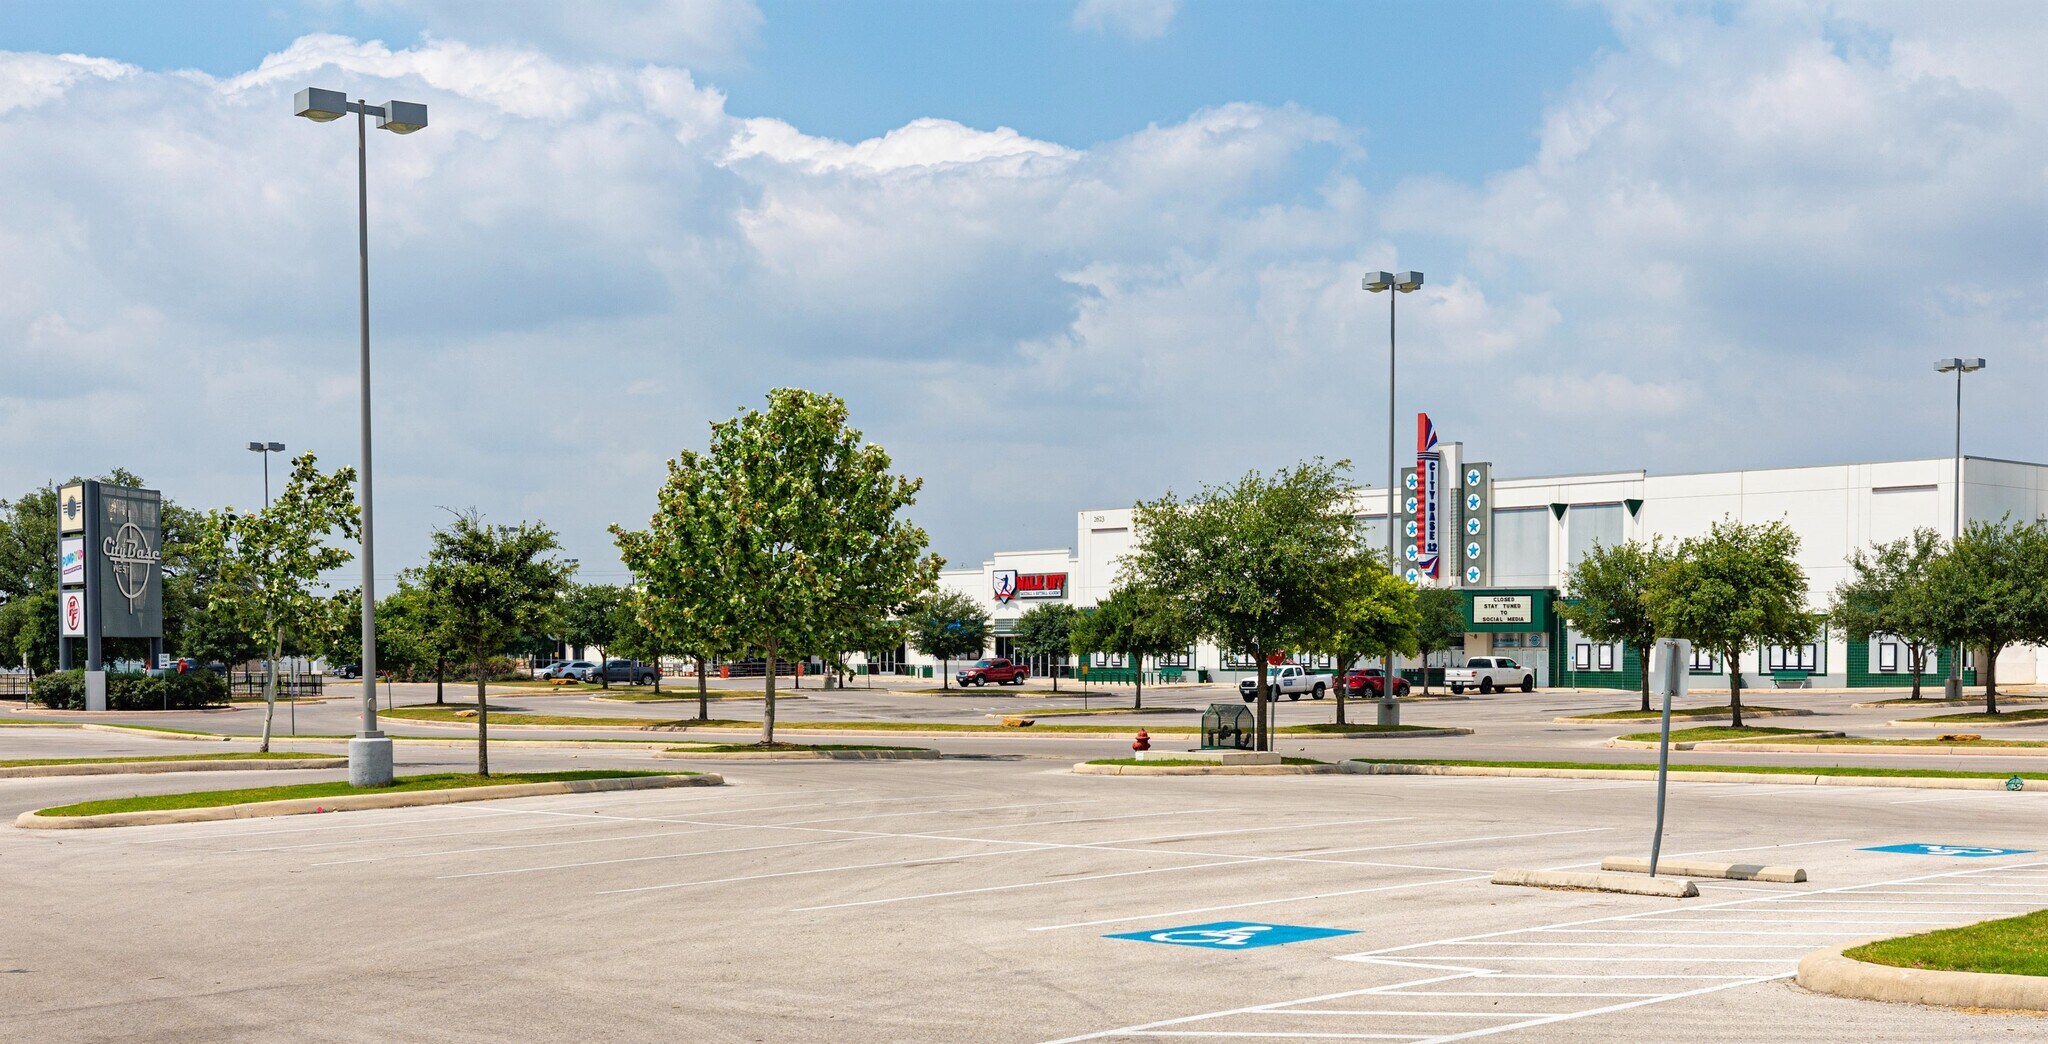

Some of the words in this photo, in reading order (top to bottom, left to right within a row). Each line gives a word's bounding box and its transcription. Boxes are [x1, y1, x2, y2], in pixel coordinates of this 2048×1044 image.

[1427, 542, 1438, 552] 12
[112, 564, 130, 574] WEST
[1016, 575, 1044, 590] WALK
[1046, 574, 1066, 590] OFF
